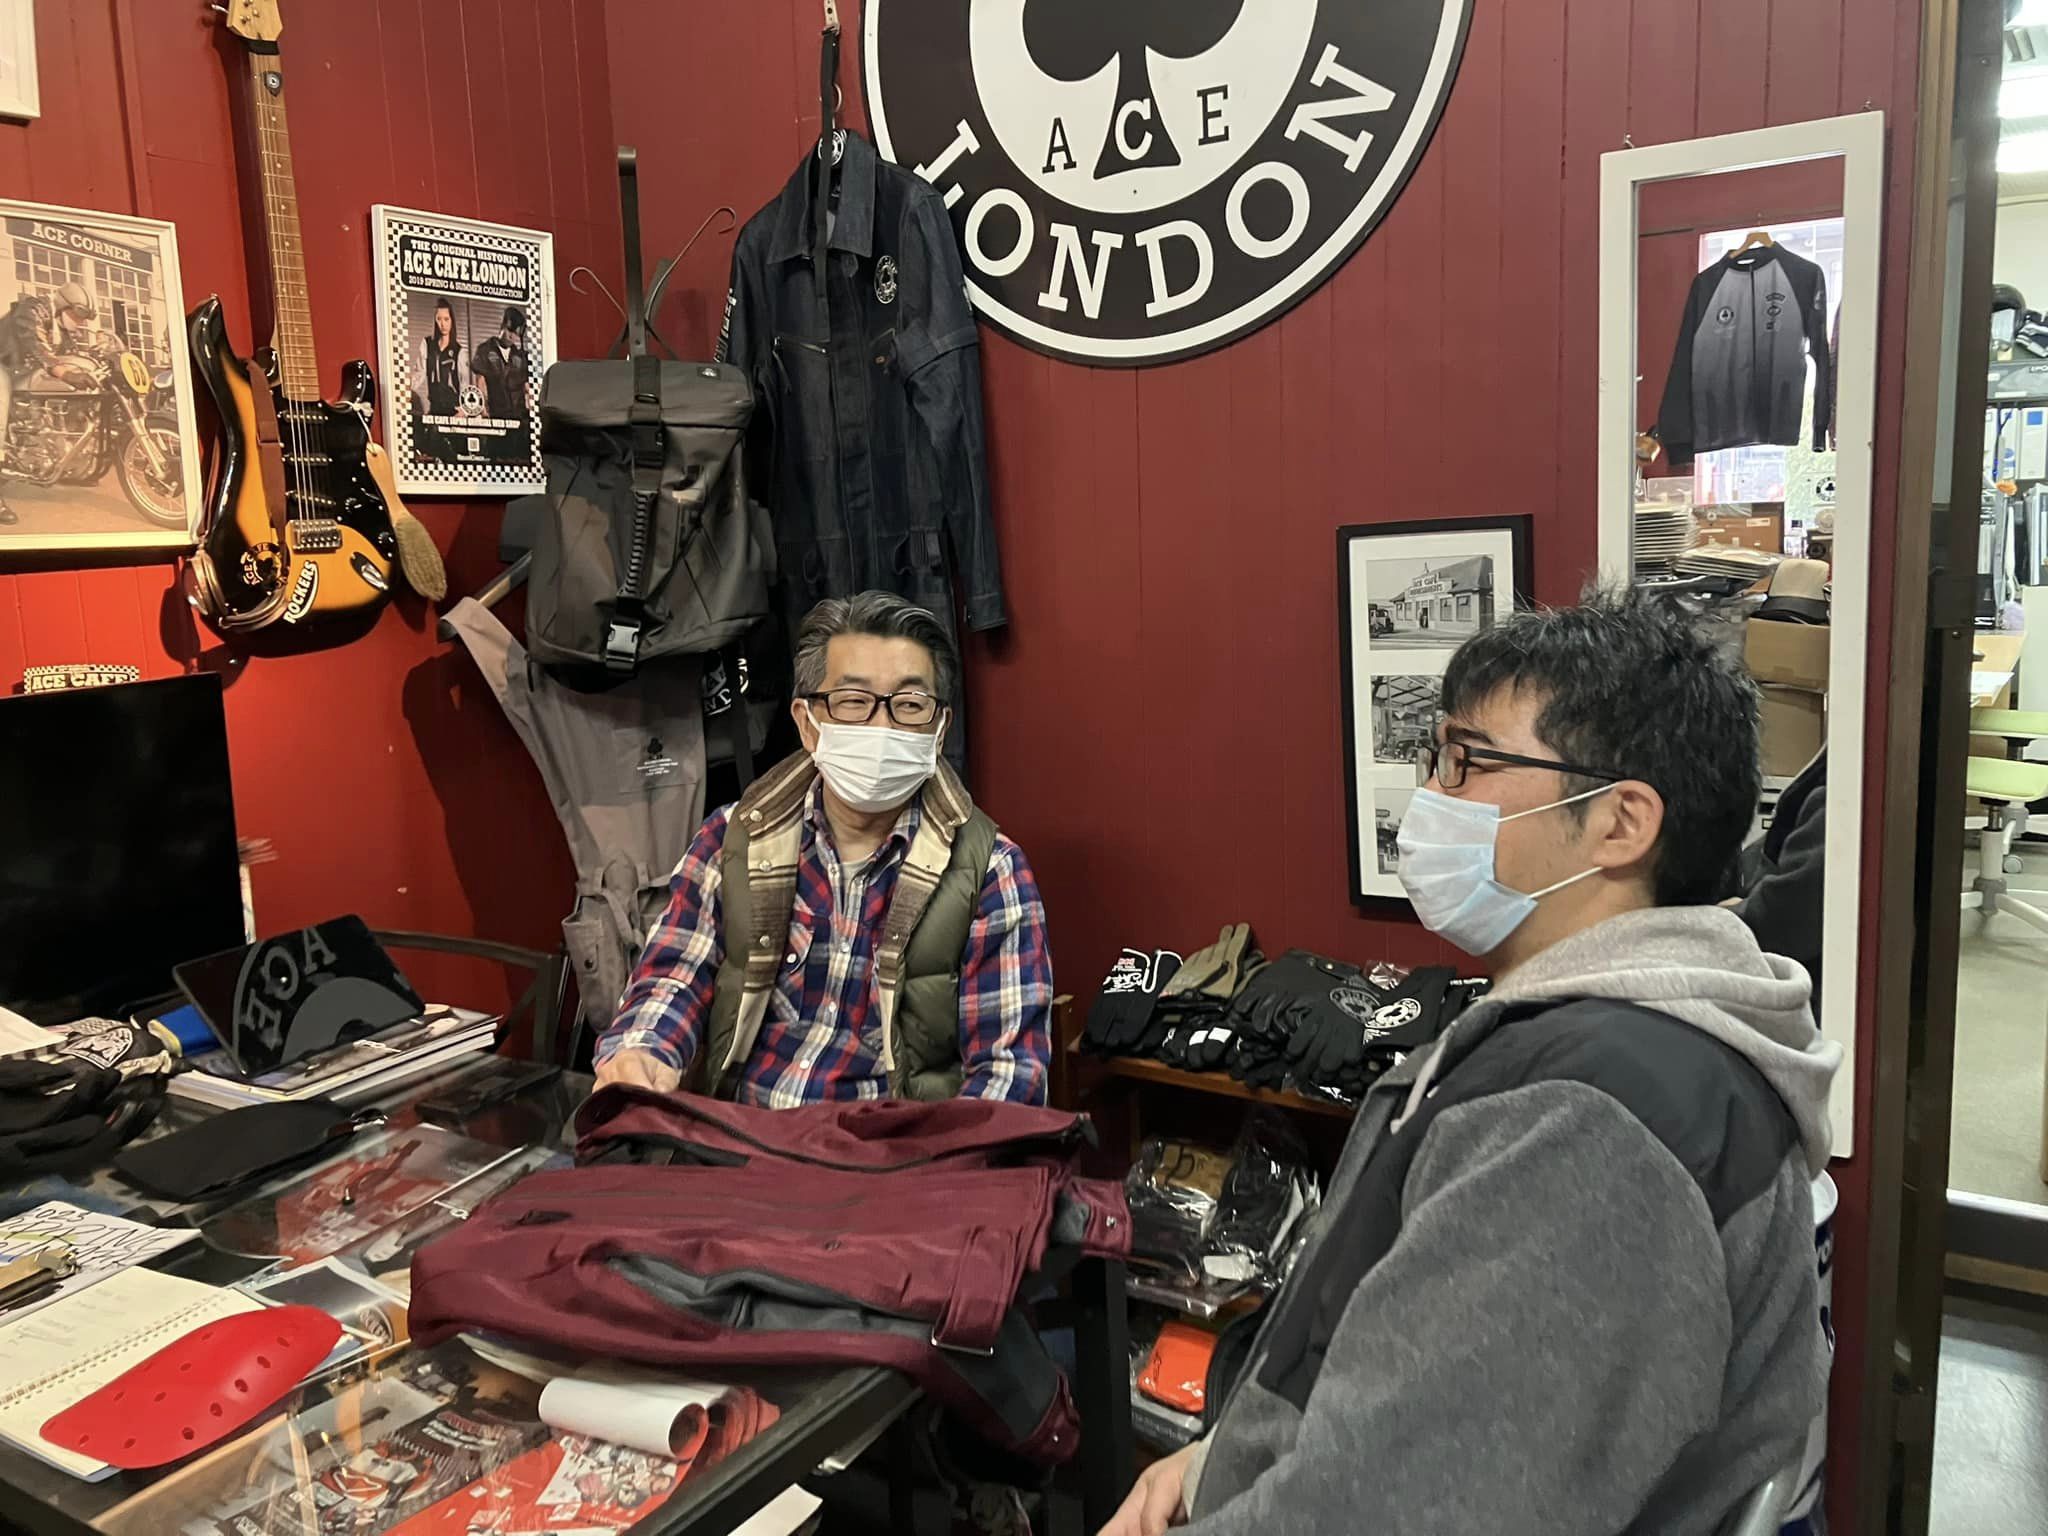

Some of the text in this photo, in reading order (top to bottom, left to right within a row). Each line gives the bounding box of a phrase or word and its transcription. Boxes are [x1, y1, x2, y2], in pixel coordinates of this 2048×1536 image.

[1041, 84, 1230, 174] ACE
[913, 43, 1397, 319] LONDON
[32, 221, 133, 263] ACE CORNER
[410, 239, 519, 265] THE ORIGINAL HISTORIC
[403, 250, 527, 290] ACE CAFE LONDON
[408, 275, 524, 299] 2019 SPRING & SUMMER COLLECTION
[283, 560, 316, 624] ROCKERS
[32, 674, 66, 690] ACE
